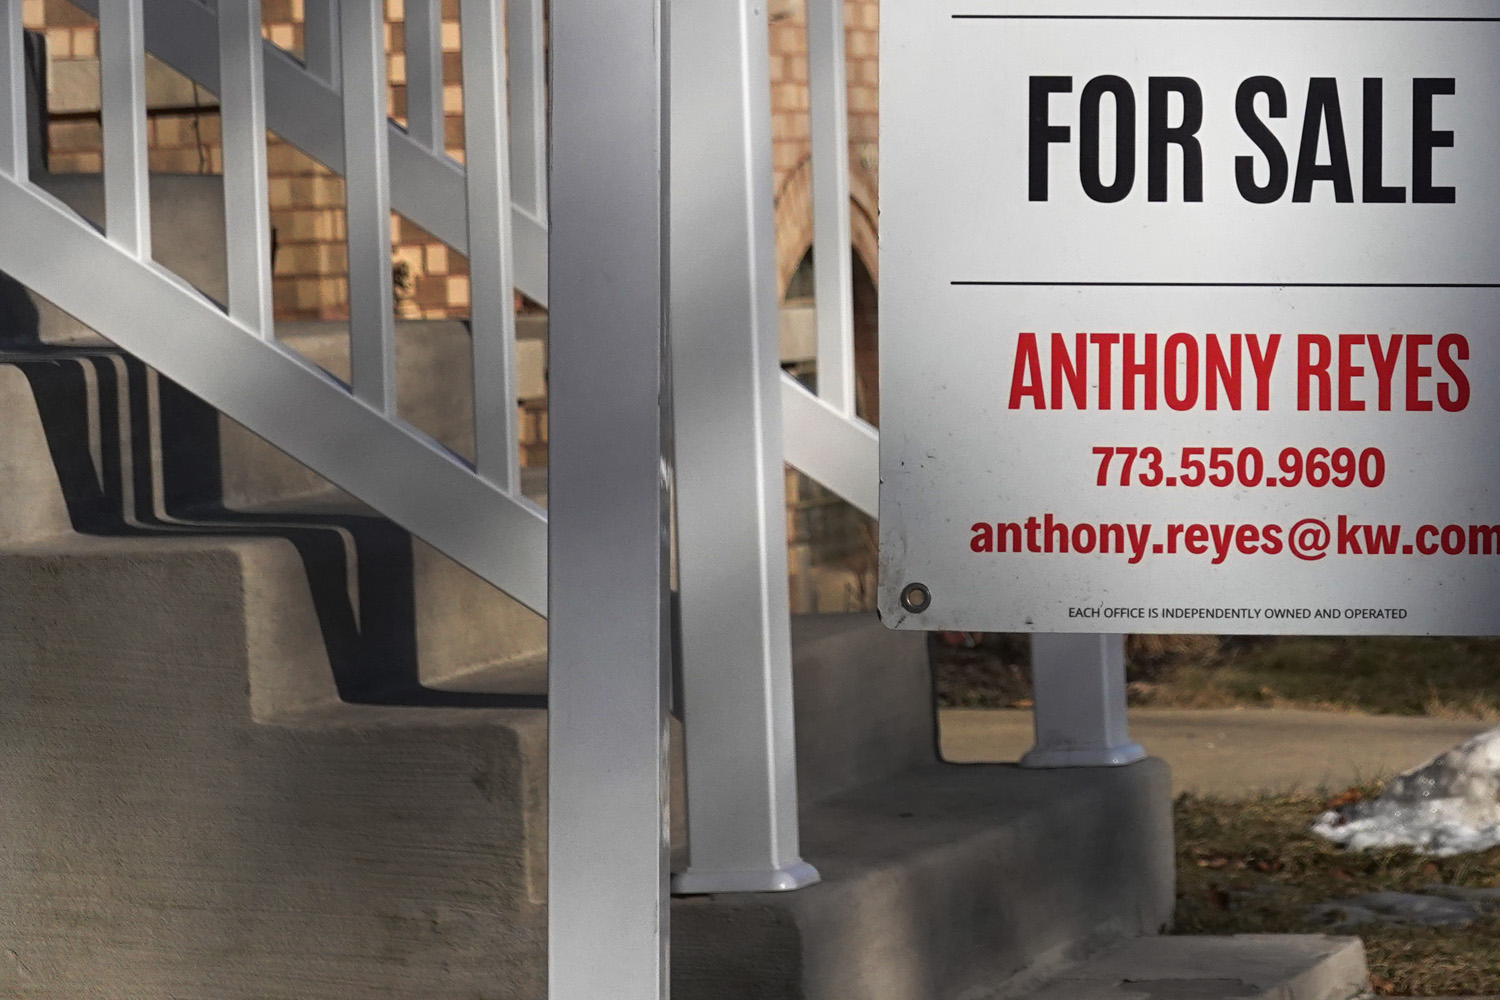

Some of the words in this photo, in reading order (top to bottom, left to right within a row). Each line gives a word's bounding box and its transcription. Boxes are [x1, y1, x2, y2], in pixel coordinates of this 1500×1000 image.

[1028, 75, 1204, 203] FOR
[1234, 75, 1456, 204] SALE
[1008, 332, 1282, 412] ANTHONY
[1297, 333, 1471, 413] REYES
[1092, 447, 1386, 488] 773.550.9690
[1068, 607, 1100, 618] EACH
[1103, 607, 1145, 618] OFFICE
[1149, 607, 1159, 619] IS
[1162, 608, 1262, 619] INDEPENDENTLY
[1264, 608, 1312, 619] OWNED
[1314, 608, 1341, 619] AND
[1344, 608, 1408, 620] OPERATED
